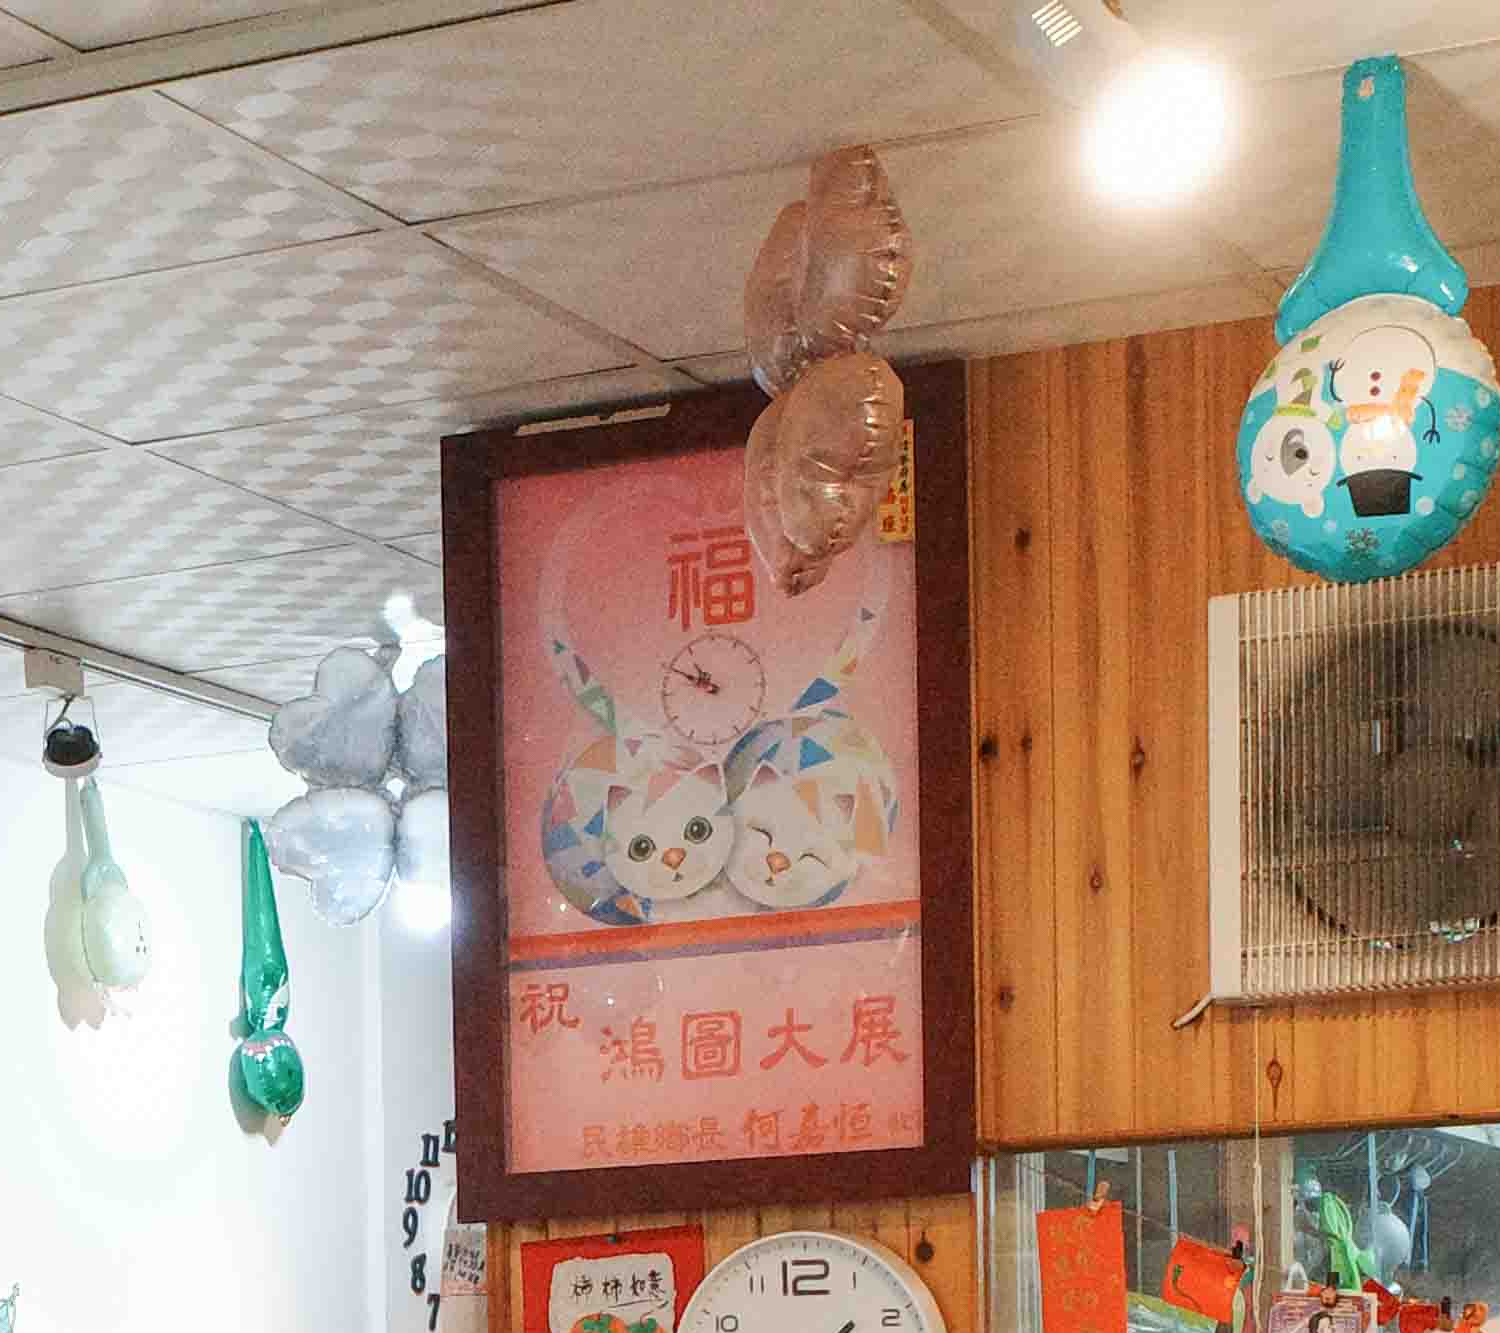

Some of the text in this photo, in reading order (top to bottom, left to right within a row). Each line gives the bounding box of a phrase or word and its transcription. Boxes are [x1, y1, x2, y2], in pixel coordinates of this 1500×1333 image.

[667, 527, 755, 632] 福
[519, 983, 908, 1083] 祝 鴻圖大展
[421, 1133, 441, 1167] 11
[405, 1168, 432, 1205] 10
[403, 1206, 419, 1249] 9
[411, 1252, 427, 1295] 8
[750, 1274, 764, 1293] 11
[781, 1258, 830, 1296] 12
[427, 1294, 441, 1332] 7
[715, 1314, 738, 1333] 10
[881, 1308, 901, 1327] 2
